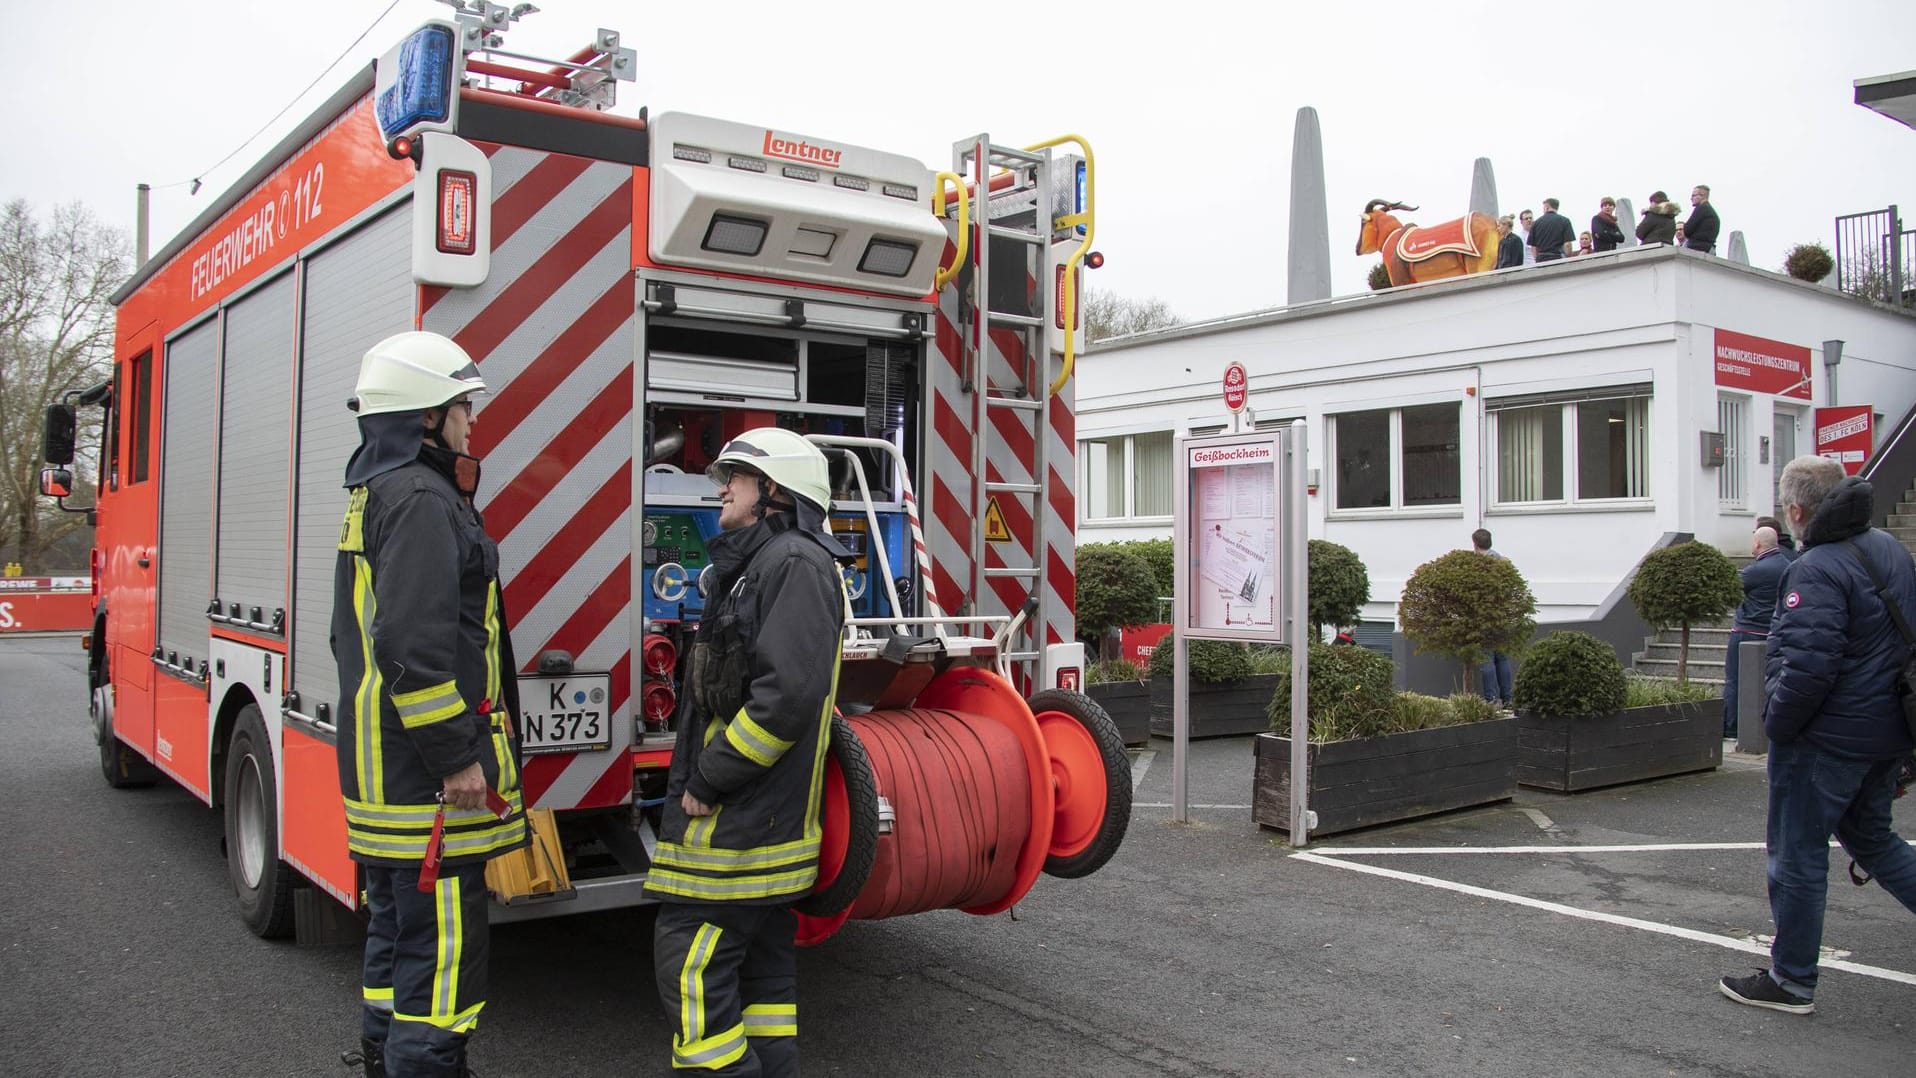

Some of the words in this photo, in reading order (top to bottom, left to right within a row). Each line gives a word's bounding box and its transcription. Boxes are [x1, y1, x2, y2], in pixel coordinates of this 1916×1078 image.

[763, 129, 842, 168] Lentner
[191, 200, 275, 302] FEUERWEHR
[294, 161, 324, 231] 112
[1717, 345, 1800, 372] NACHWUCHSLEISTUNGSZENTRUM
[1194, 447, 1270, 463] Geißbockheim
[1137, 645, 1157, 656] CHEF
[550, 682, 567, 710] K
[520, 714, 544, 743] N
[550, 711, 600, 741] 373
